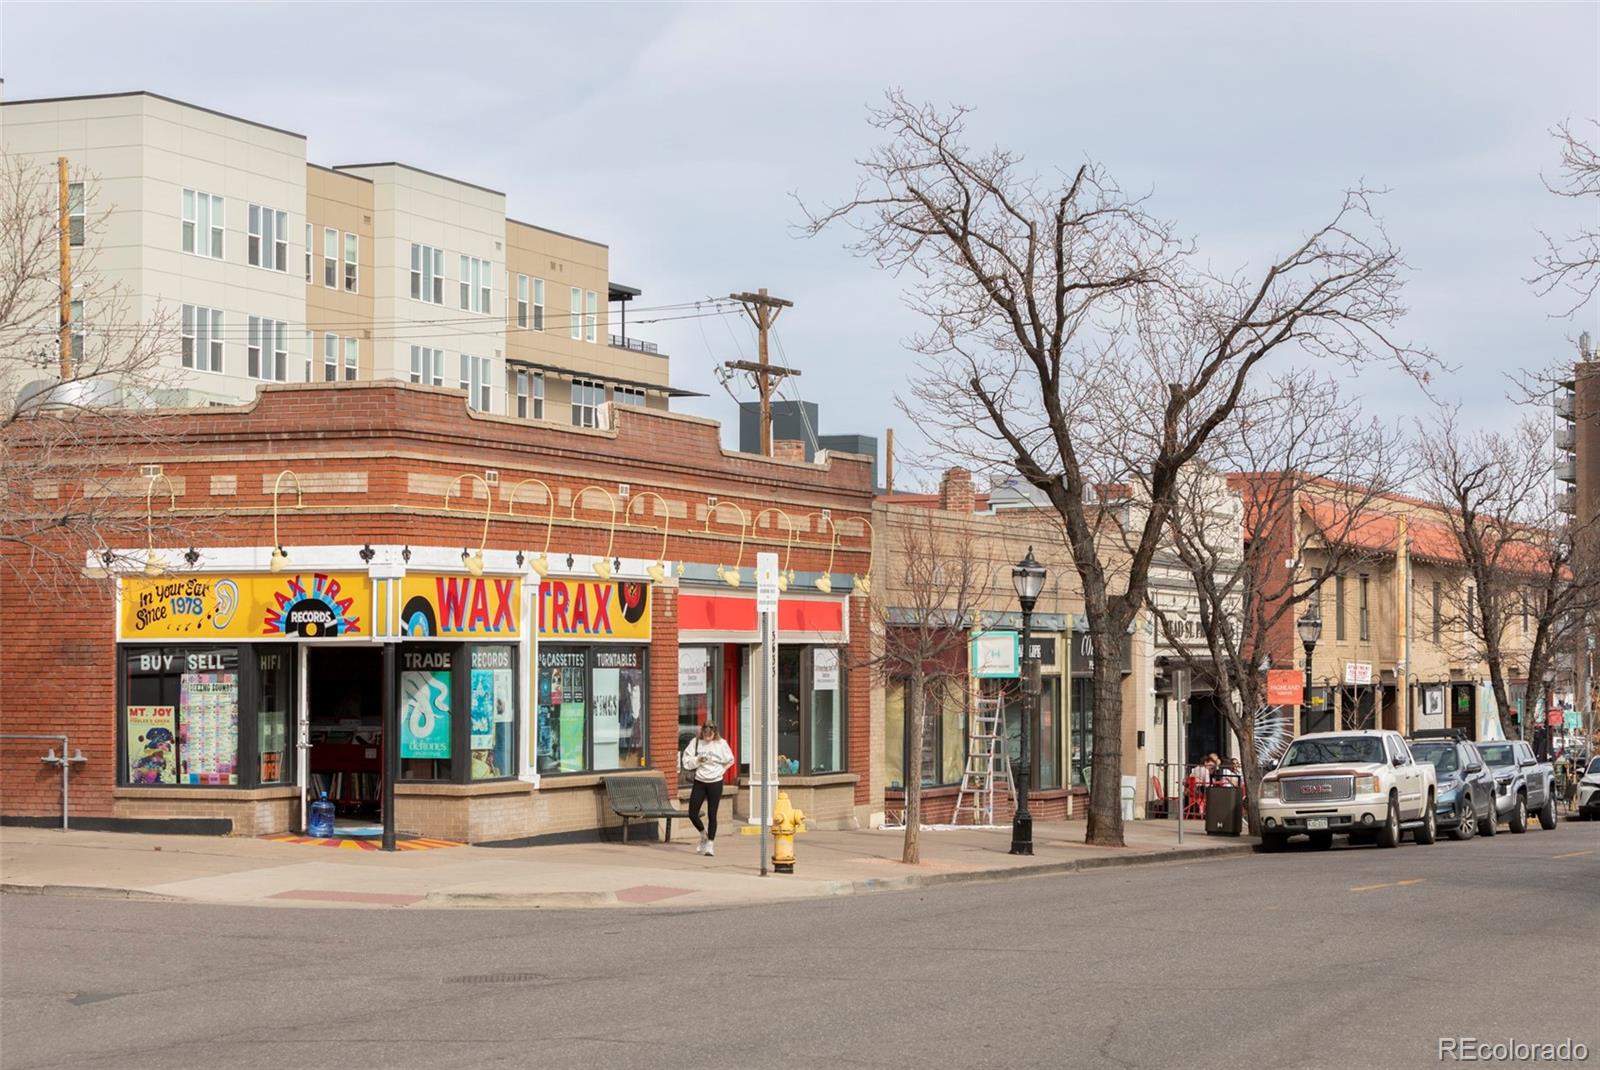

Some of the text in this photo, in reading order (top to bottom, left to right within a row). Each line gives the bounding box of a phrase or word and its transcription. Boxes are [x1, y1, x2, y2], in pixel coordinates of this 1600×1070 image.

[139, 592, 153, 608] In
[185, 578, 210, 597] Ear
[262, 572, 361, 635] WAX TRAX
[435, 576, 614, 634] WAX TRAX
[135, 596, 203, 631] Since 1978
[291, 611, 332, 623] RECORDS
[140, 654, 225, 671] BUY SELL
[260, 655, 281, 670] HIFI
[404, 652, 451, 668] TRADE
[471, 652, 509, 668] RECORDS
[546, 653, 585, 667] CASSETTES
[597, 652, 638, 667] TURNTABLES
[152, 707, 172, 717] JOY
